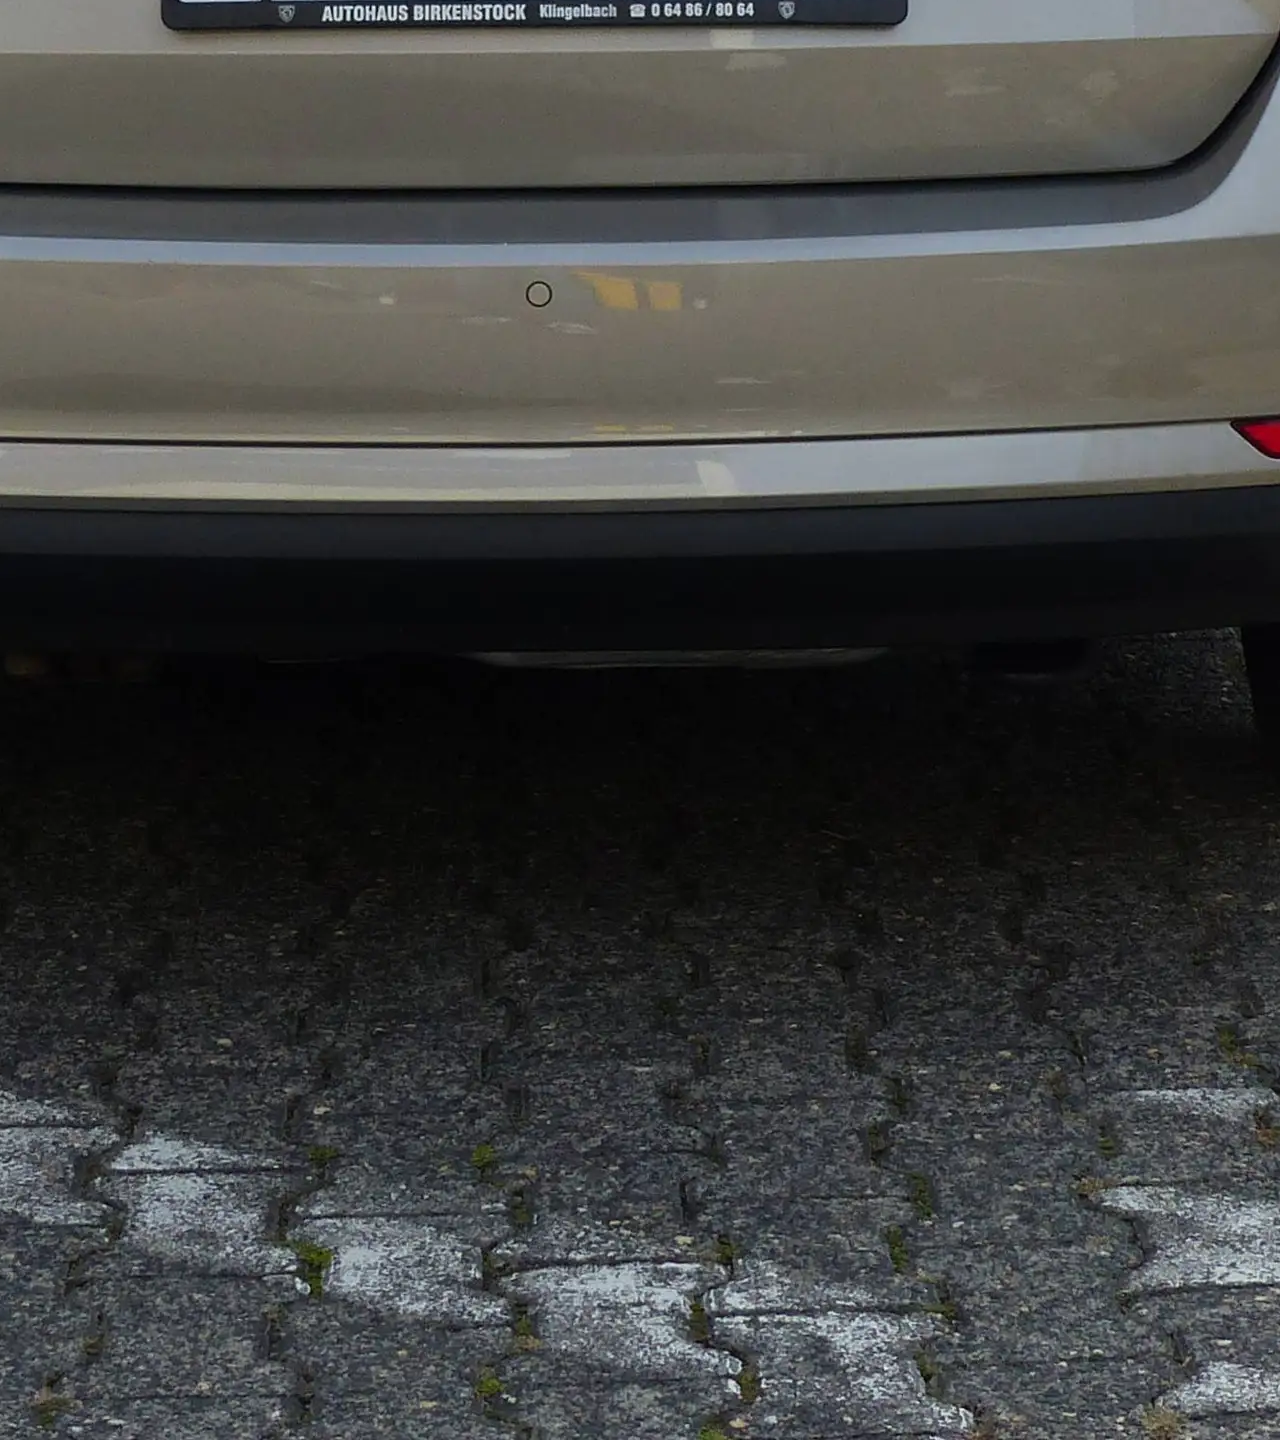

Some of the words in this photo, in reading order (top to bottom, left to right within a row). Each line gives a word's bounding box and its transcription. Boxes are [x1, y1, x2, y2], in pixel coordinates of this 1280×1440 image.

[321, 4, 408, 22] AUTOHAUS
[413, 3, 526, 21] BIRKENSTOCK
[539, 3, 618, 20] Klingelbach
[651, 3, 660, 17] 0
[664, 2, 682, 17] 64
[685, 2, 703, 17] 86
[715, 1, 733, 16] 80
[736, 1, 755, 16] 64
